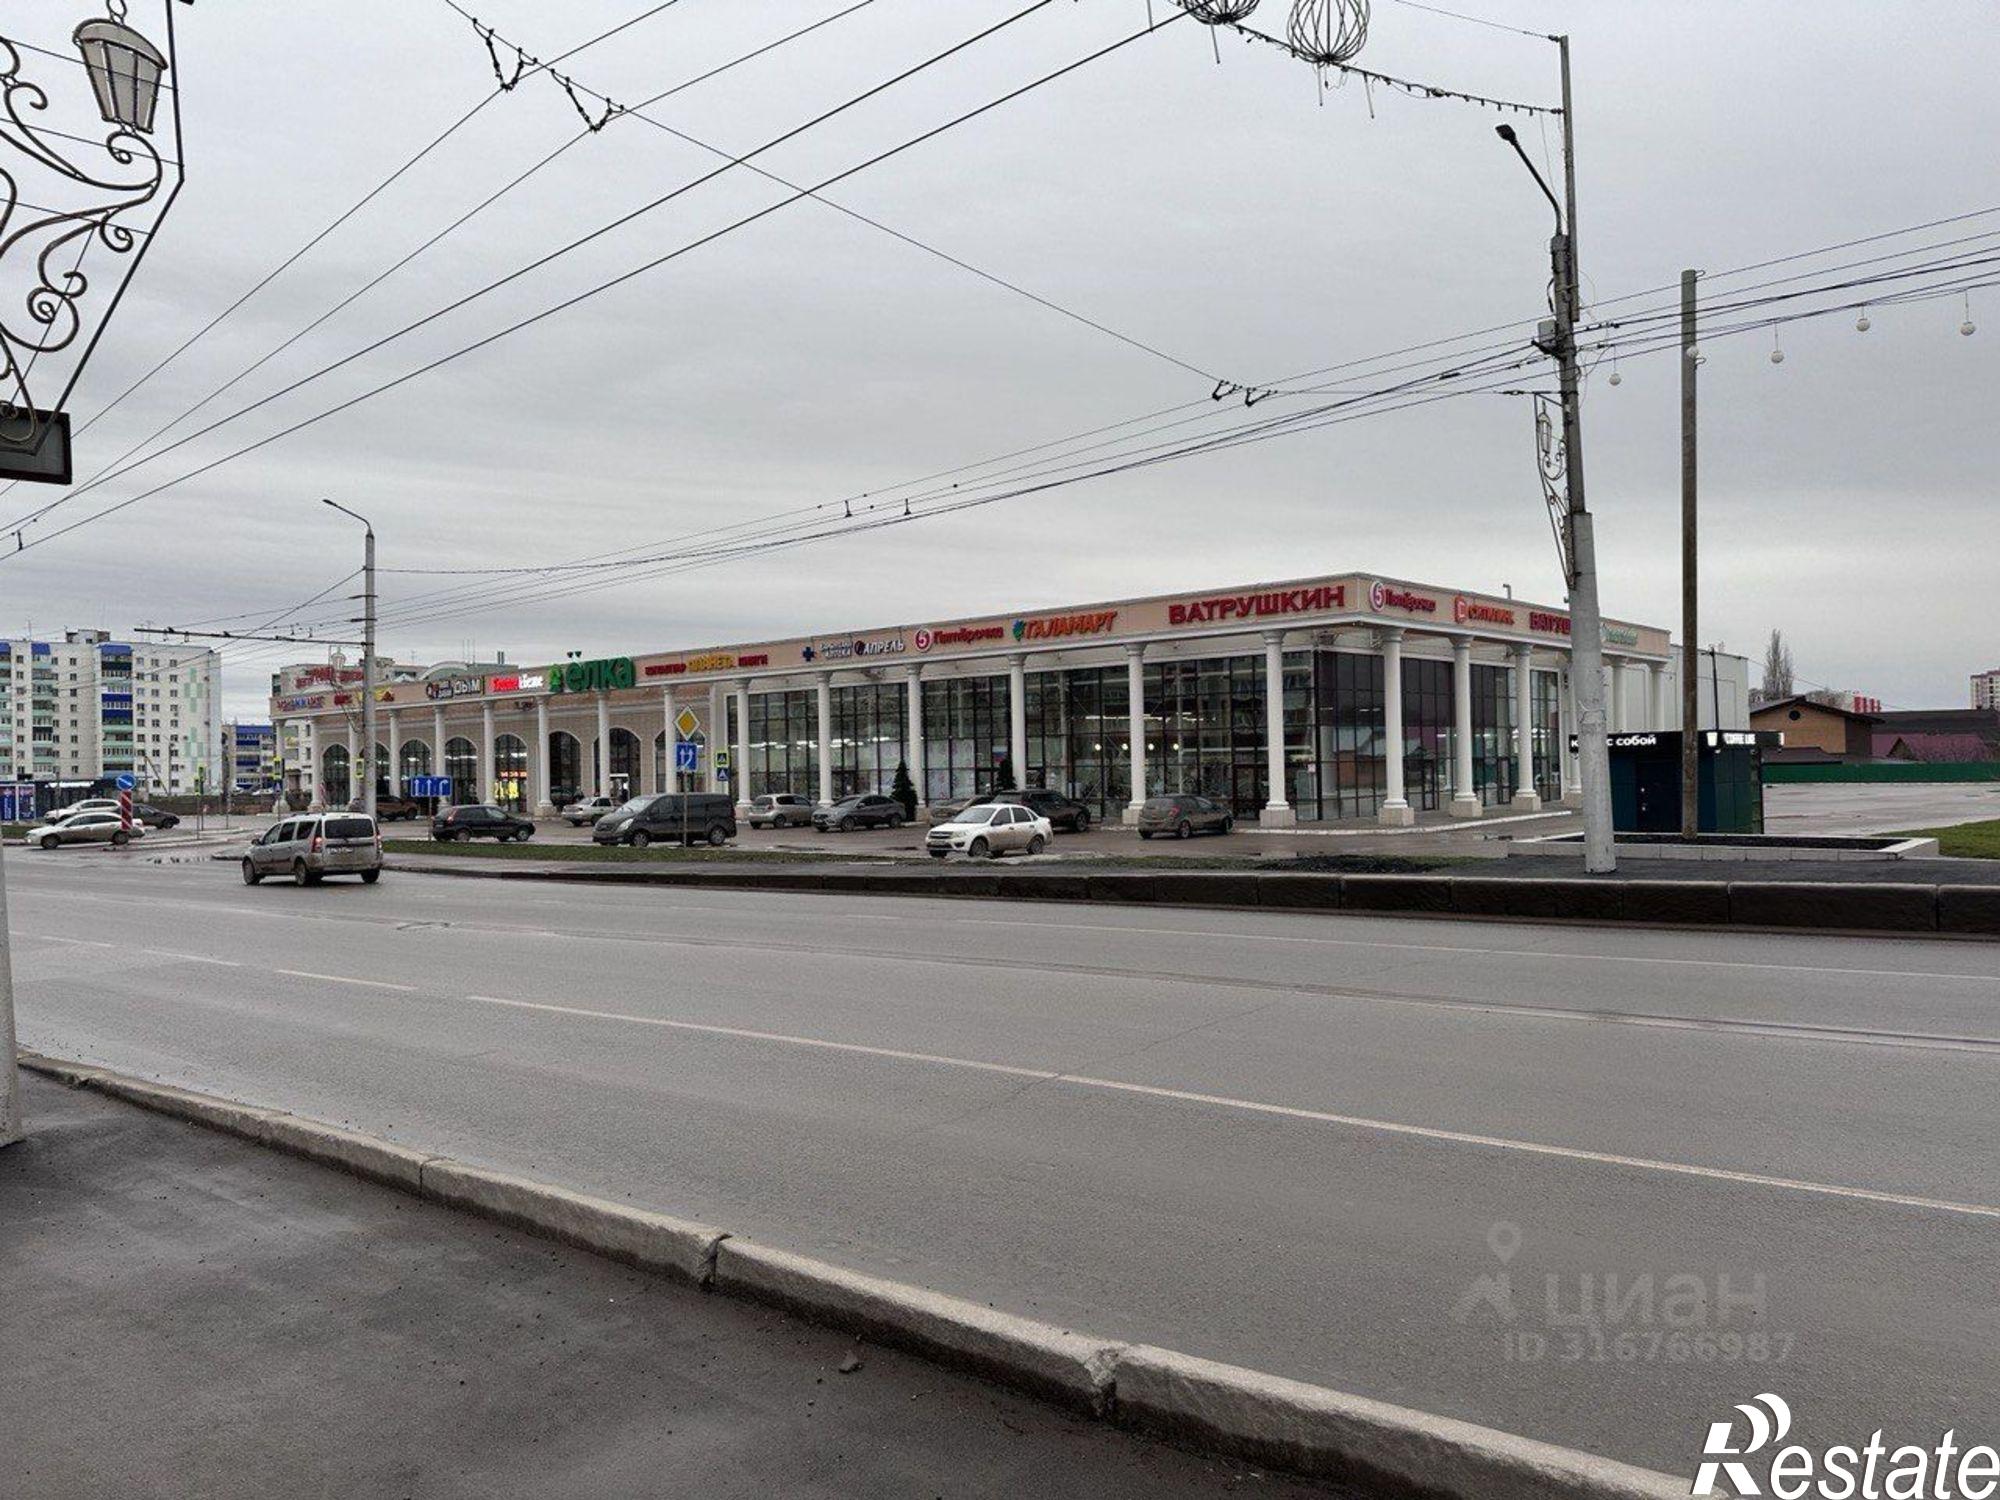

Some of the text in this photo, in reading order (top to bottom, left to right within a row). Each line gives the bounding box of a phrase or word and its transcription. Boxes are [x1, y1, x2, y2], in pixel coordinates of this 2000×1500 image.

[1168, 586, 1345, 625] ВАТРУШКИН
[1026, 611, 1118, 639] ГАЛАМАРТ
[864, 639, 904, 656] АПРЕЛЬ
[1616, 734, 1657, 747] собой
